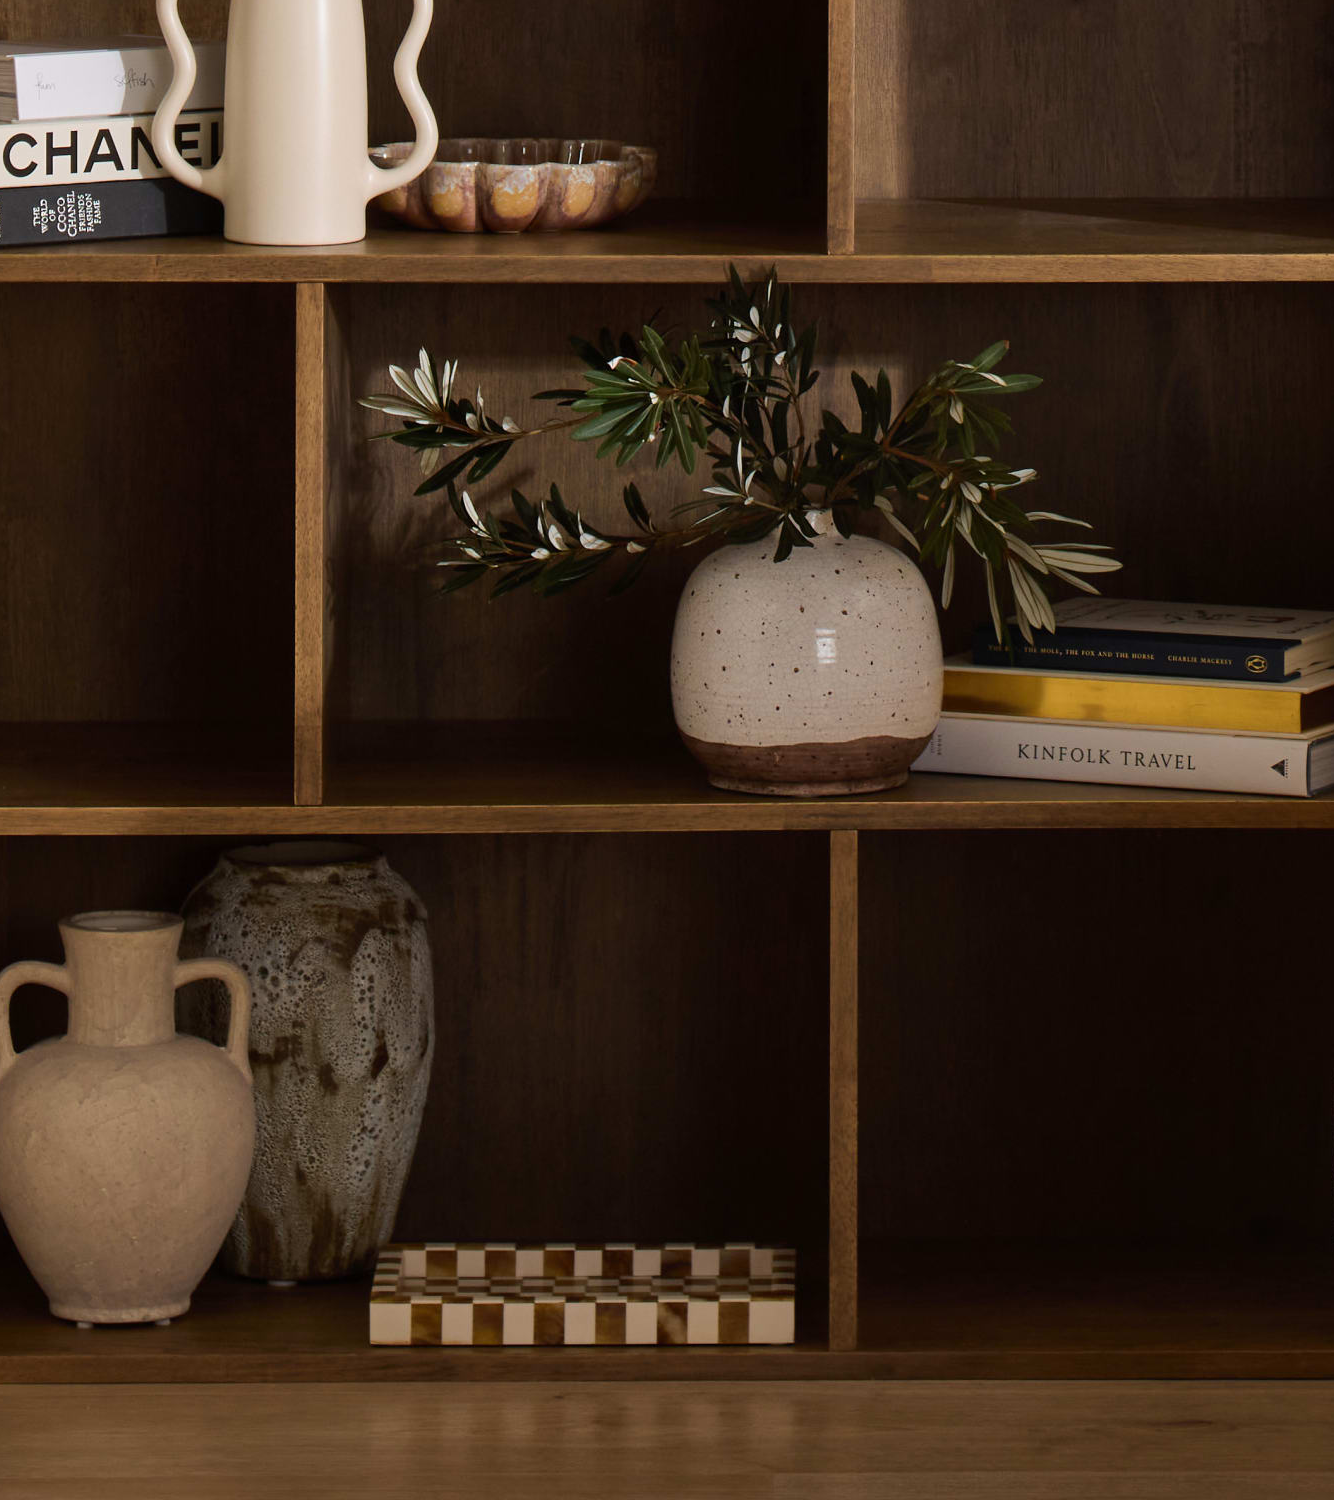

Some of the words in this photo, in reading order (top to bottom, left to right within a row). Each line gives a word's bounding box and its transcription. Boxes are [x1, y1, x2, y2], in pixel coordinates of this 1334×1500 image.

[33, 206, 41, 227] THE
[40, 199, 49, 234] WORLD
[48, 209, 56, 222] OF
[57, 197, 67, 232] COCO
[67, 191, 78, 237] CHANEL
[77, 194, 86, 232] FRIENDS
[85, 193, 95, 232] FASHION
[93, 199, 102, 225] FAME
[1167, 655, 1198, 663] CHARLIE
[1018, 743, 1112, 766] KINFOLK
[1119, 750, 1197, 772] TRAVEL
